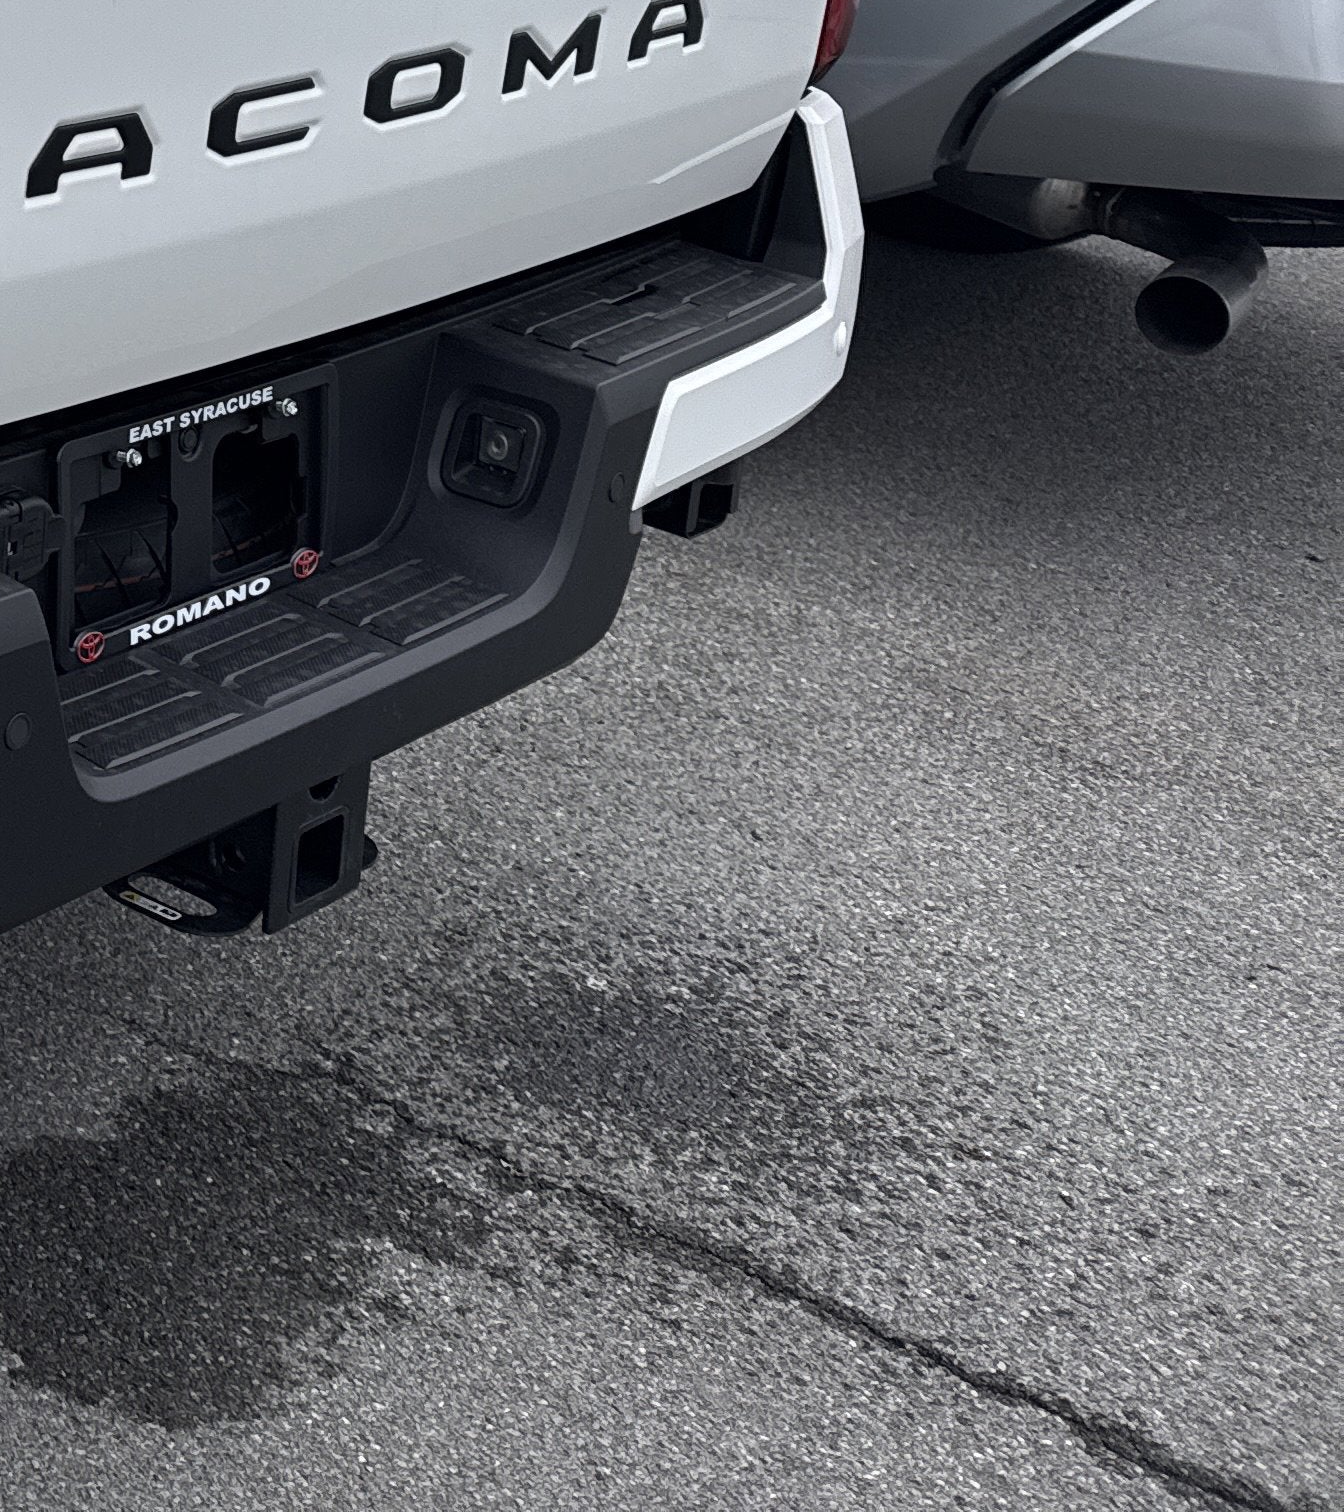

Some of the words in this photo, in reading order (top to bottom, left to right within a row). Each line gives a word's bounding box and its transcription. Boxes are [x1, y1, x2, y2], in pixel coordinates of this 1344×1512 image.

[128, 416, 175, 443] EAST
[179, 386, 274, 429] SYRACUSE
[129, 577, 271, 645] ROMANO
